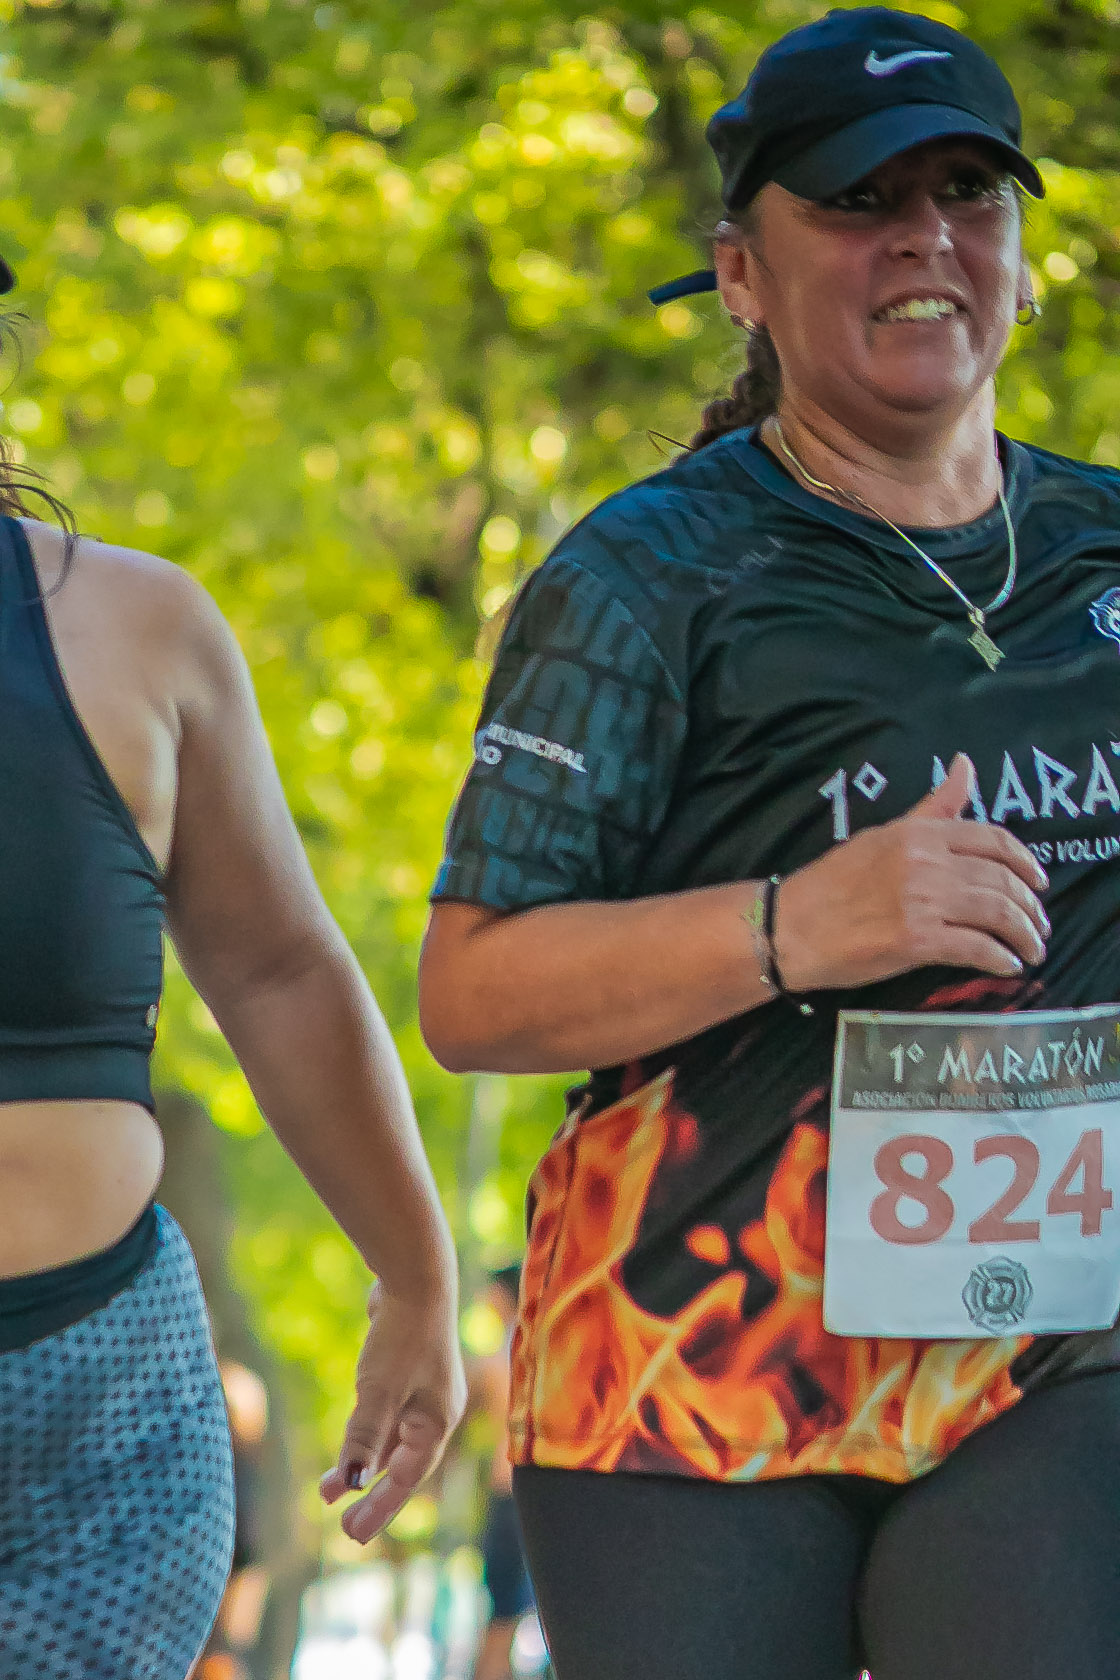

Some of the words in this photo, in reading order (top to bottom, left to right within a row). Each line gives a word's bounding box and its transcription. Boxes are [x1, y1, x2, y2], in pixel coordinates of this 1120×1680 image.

[932, 741, 1120, 824] ARA
[937, 1027, 1103, 1084] MARATÓN
[870, 1128, 1112, 1244] 824
